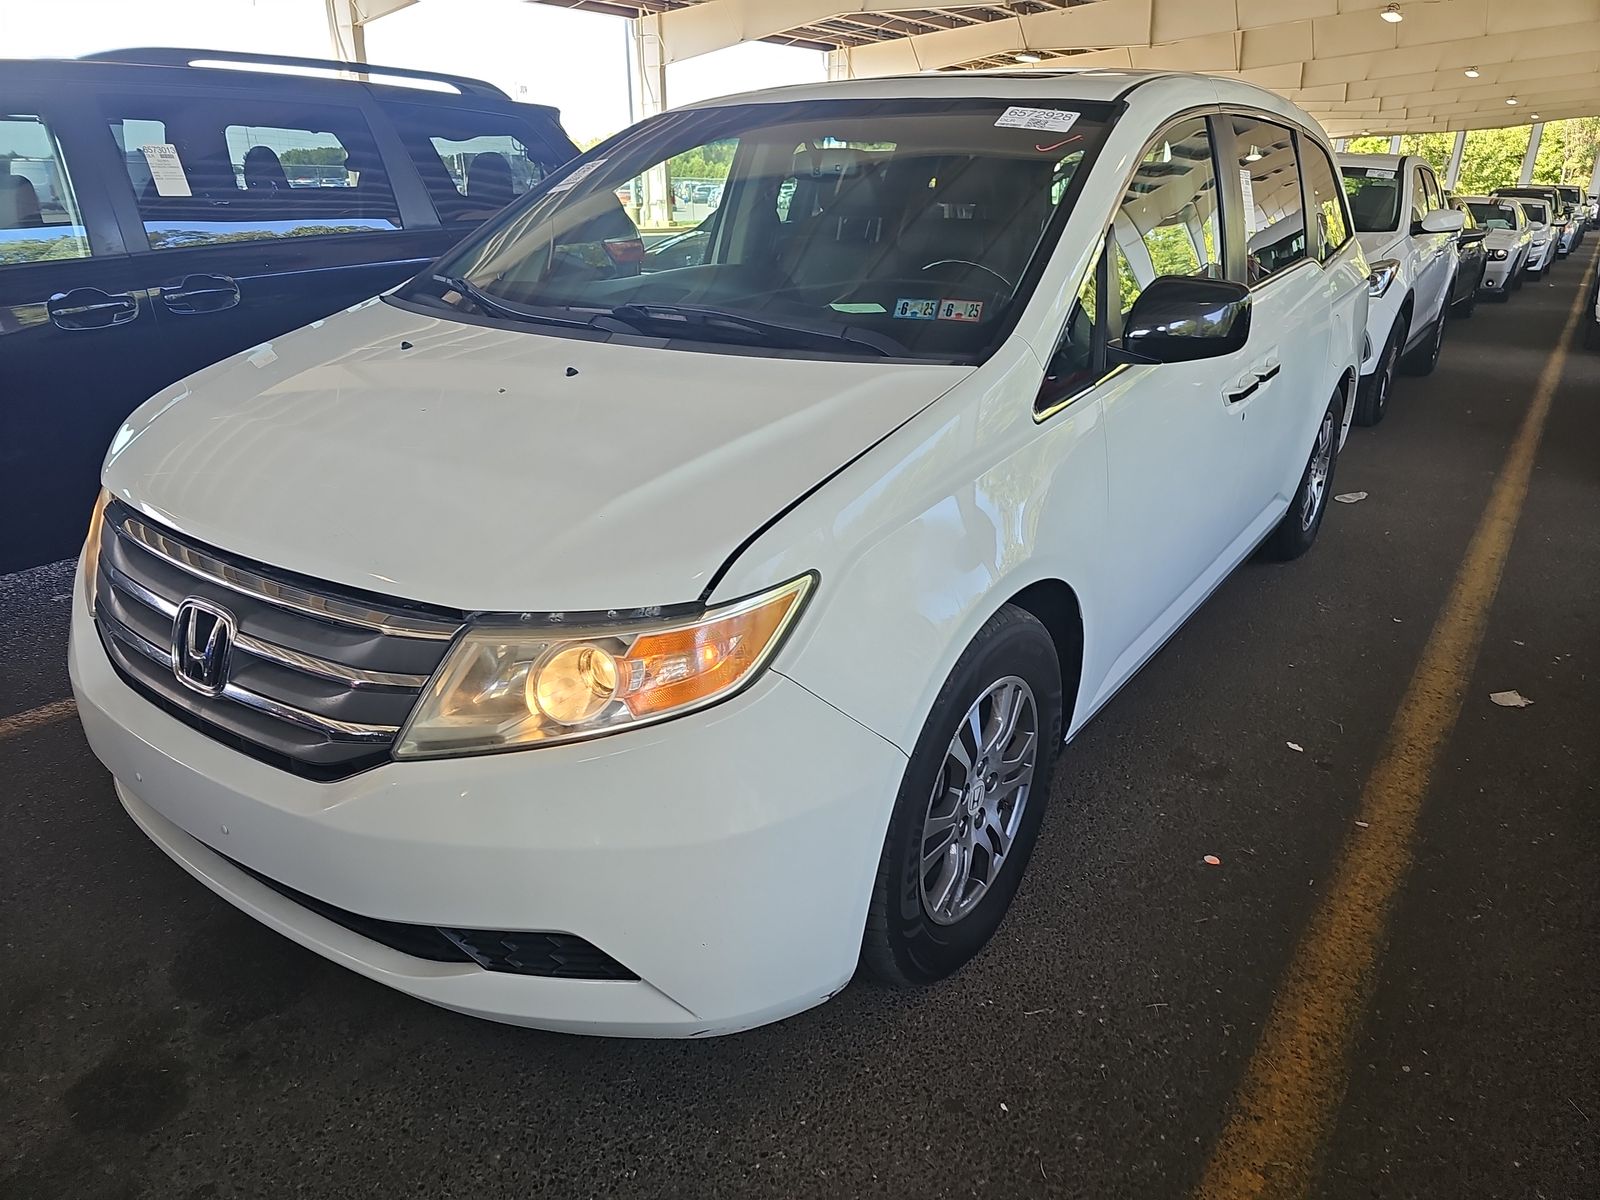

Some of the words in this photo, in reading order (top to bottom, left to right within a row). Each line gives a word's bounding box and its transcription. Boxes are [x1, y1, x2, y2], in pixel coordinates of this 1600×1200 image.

[1008, 109, 1074, 121] 6572928
[143, 145, 176, 155] 6573013
[900, 301, 909, 316] 6
[923, 302, 935, 316] 25
[945, 303, 954, 317] 6
[968, 303, 981, 318] 25
